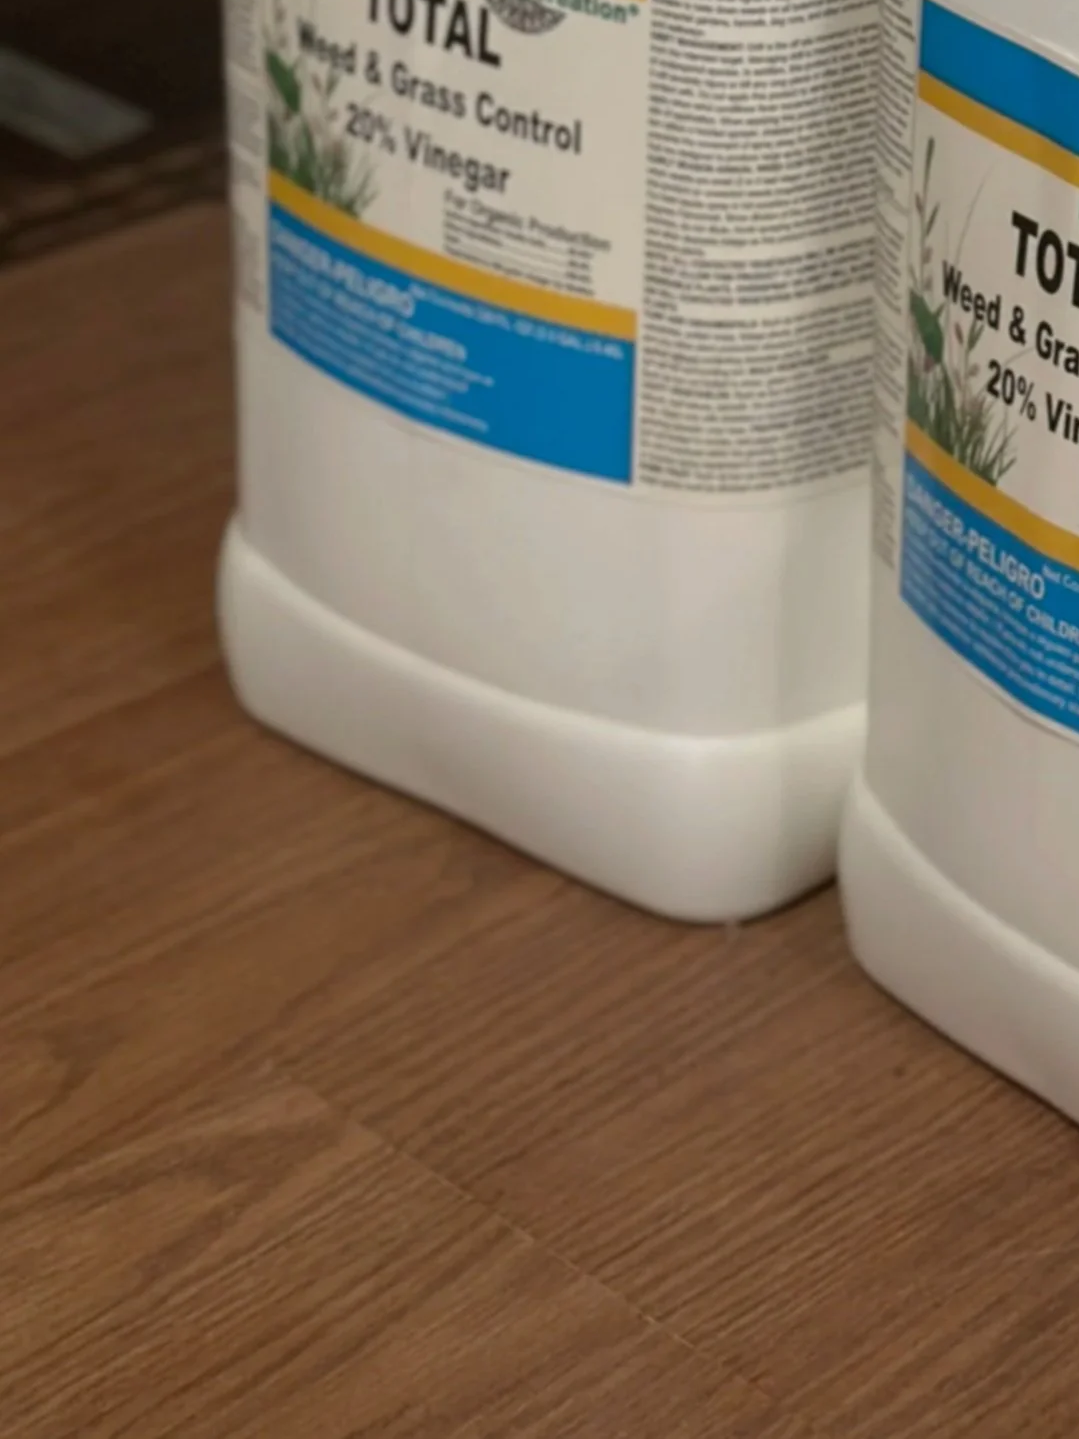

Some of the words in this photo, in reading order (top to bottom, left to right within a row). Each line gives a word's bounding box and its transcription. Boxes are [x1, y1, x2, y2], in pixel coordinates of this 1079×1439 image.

[297, 18, 356, 76] Weed
[365, 53, 381, 84] &
[389, 62, 466, 126] Grass
[475, 92, 582, 155] Control
[345, 103, 396, 154] 20%
[404, 124, 511, 195] Vinegar
[469, 199, 523, 230] Organic
[528, 214, 613, 252] Production
[941, 260, 1002, 331] Weed
[1009, 305, 1027, 346] &
[986, 360, 1037, 421] 20%
